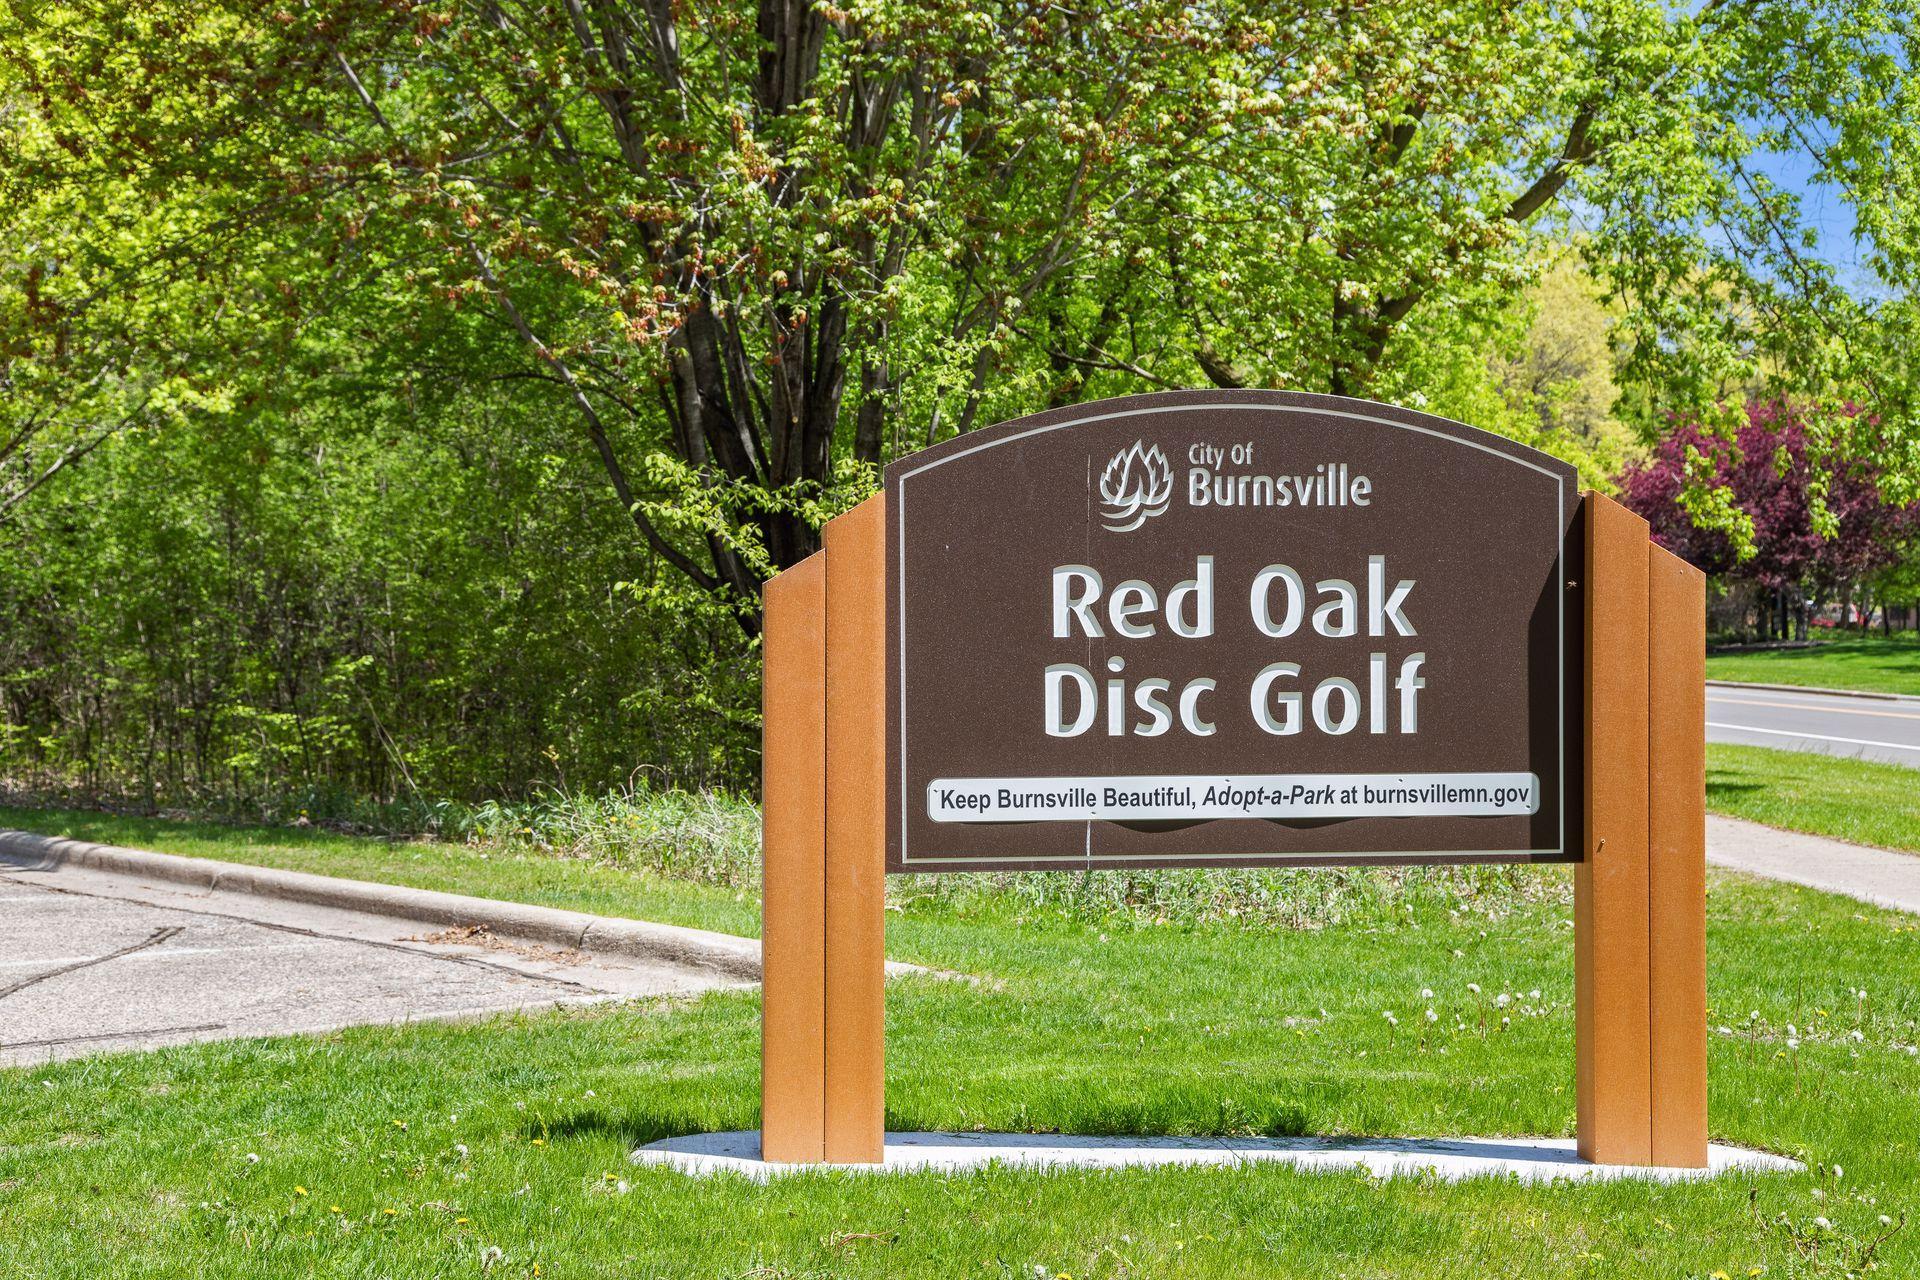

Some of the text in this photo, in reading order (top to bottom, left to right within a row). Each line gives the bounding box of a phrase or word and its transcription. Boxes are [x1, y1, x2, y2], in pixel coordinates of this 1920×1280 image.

[1188, 441, 1225, 470] City
[1188, 462, 1372, 506] Burnsville
[1052, 554, 1419, 639] Red Oak
[1044, 651, 1426, 737] Disc Golf
[941, 783, 1529, 813] Keep Burnsville Beautiful, Adopt-a-Park at burnsvillemn.gov
